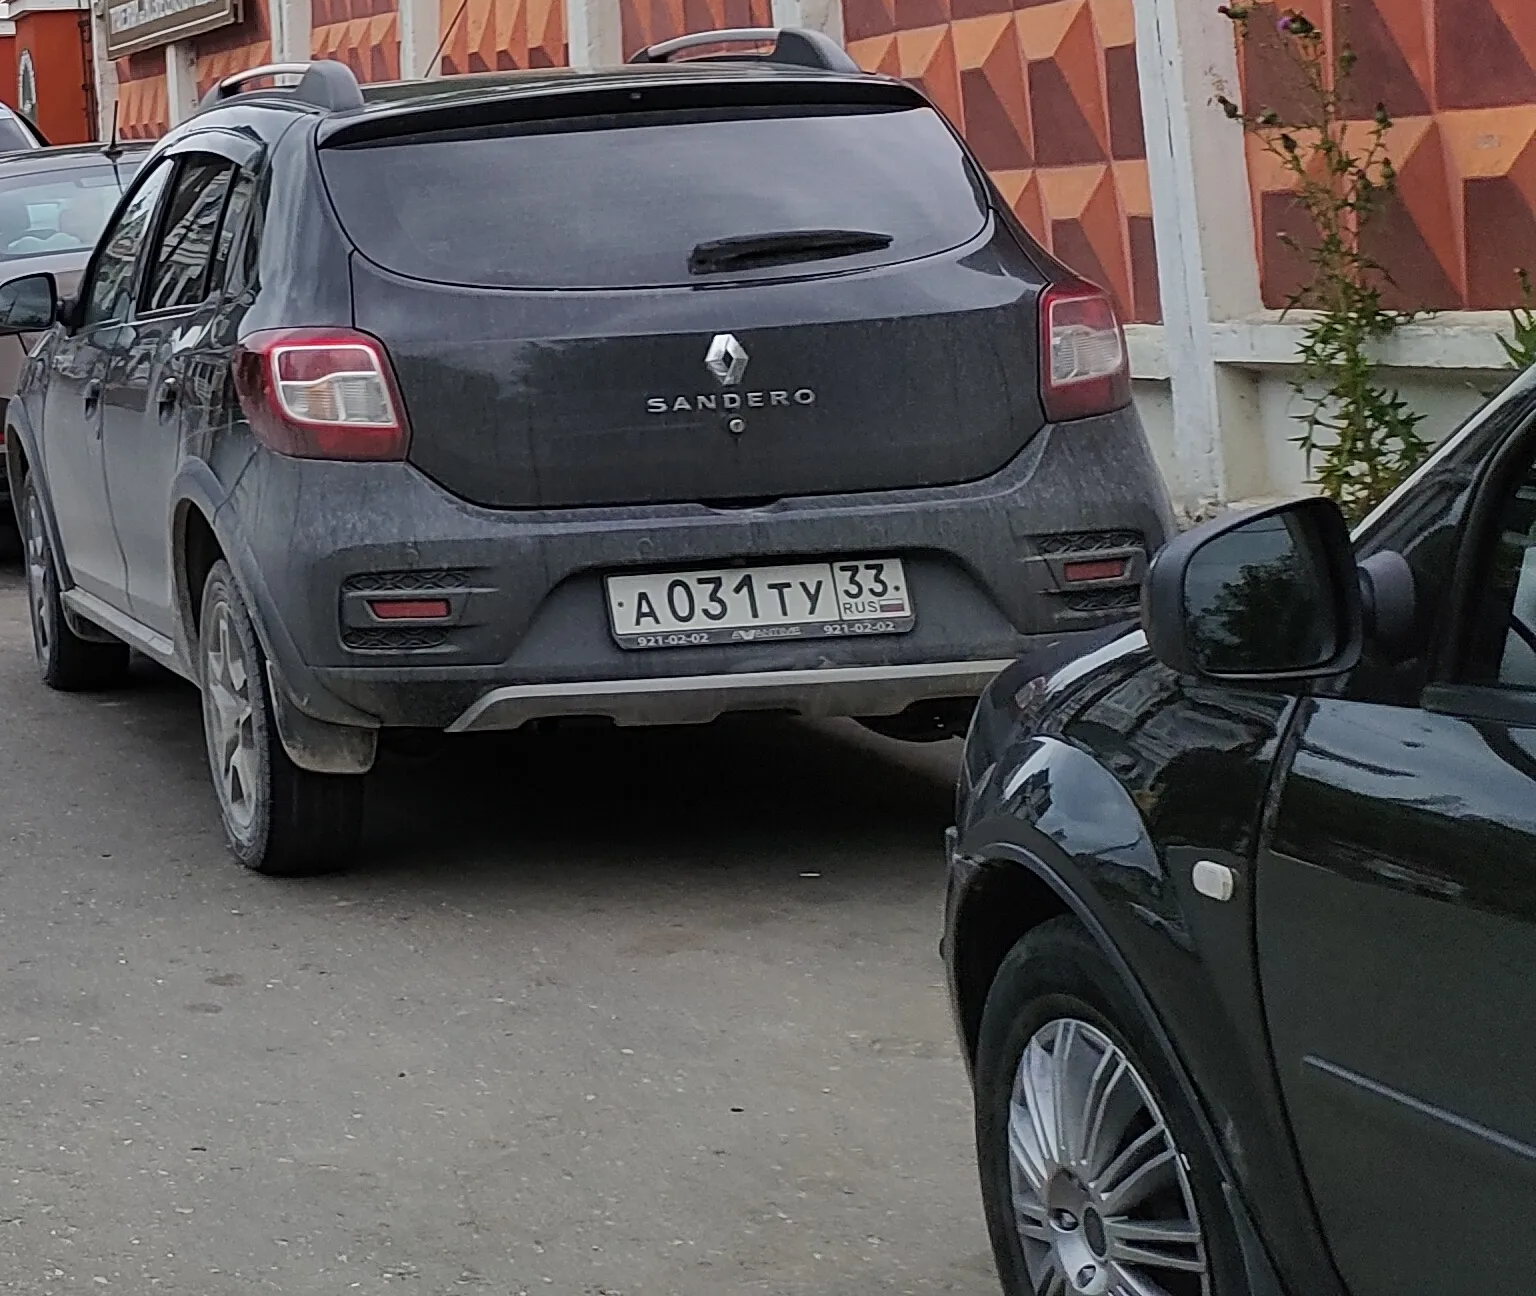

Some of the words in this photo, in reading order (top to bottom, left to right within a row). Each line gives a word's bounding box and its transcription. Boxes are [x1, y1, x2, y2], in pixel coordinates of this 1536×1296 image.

[647, 388, 817, 413] SANDERO
[634, 572, 823, 627] А031ТУ
[843, 600, 878, 614] RUS
[637, 632, 710, 647] 921-02-02
[823, 620, 896, 636] 921-02-02
